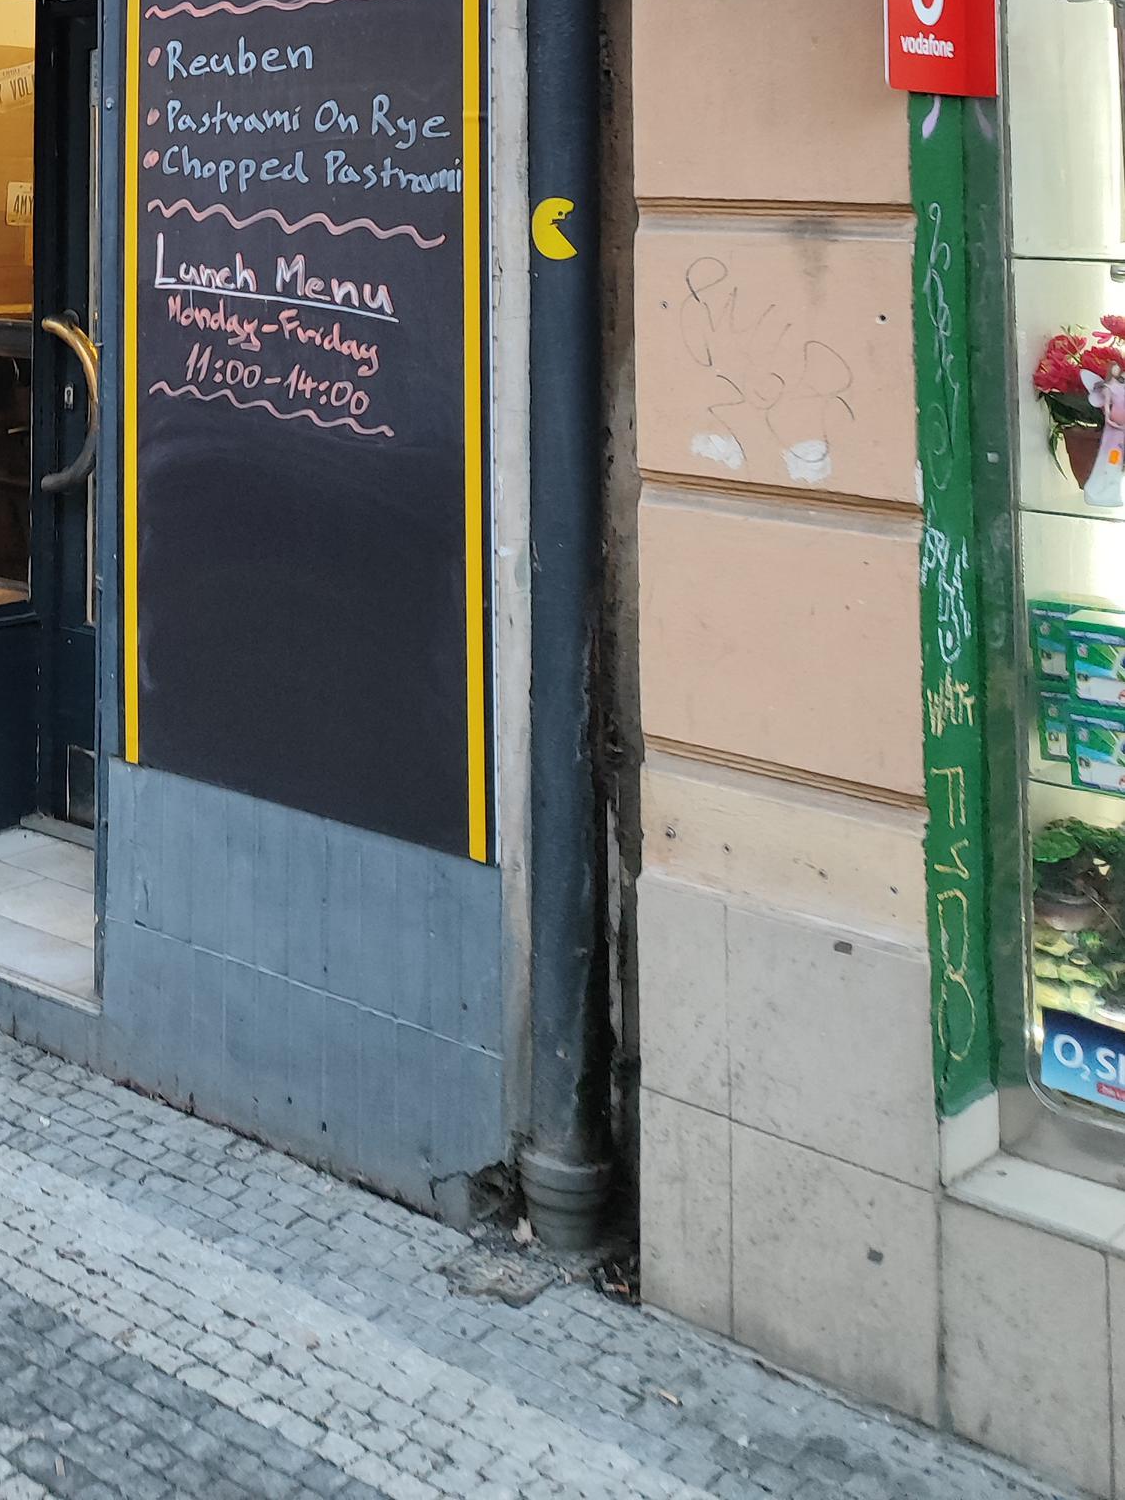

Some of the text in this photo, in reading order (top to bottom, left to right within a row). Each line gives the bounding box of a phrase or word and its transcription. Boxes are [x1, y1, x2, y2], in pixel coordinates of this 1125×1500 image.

[165, 35, 315, 82] Reuben
[899, 32, 955, 59] vodafone
[166, 93, 452, 151] Pastrami On Rye
[162, 144, 463, 195] Chopped Pastrami
[155, 231, 396, 316] Lunch Menu
